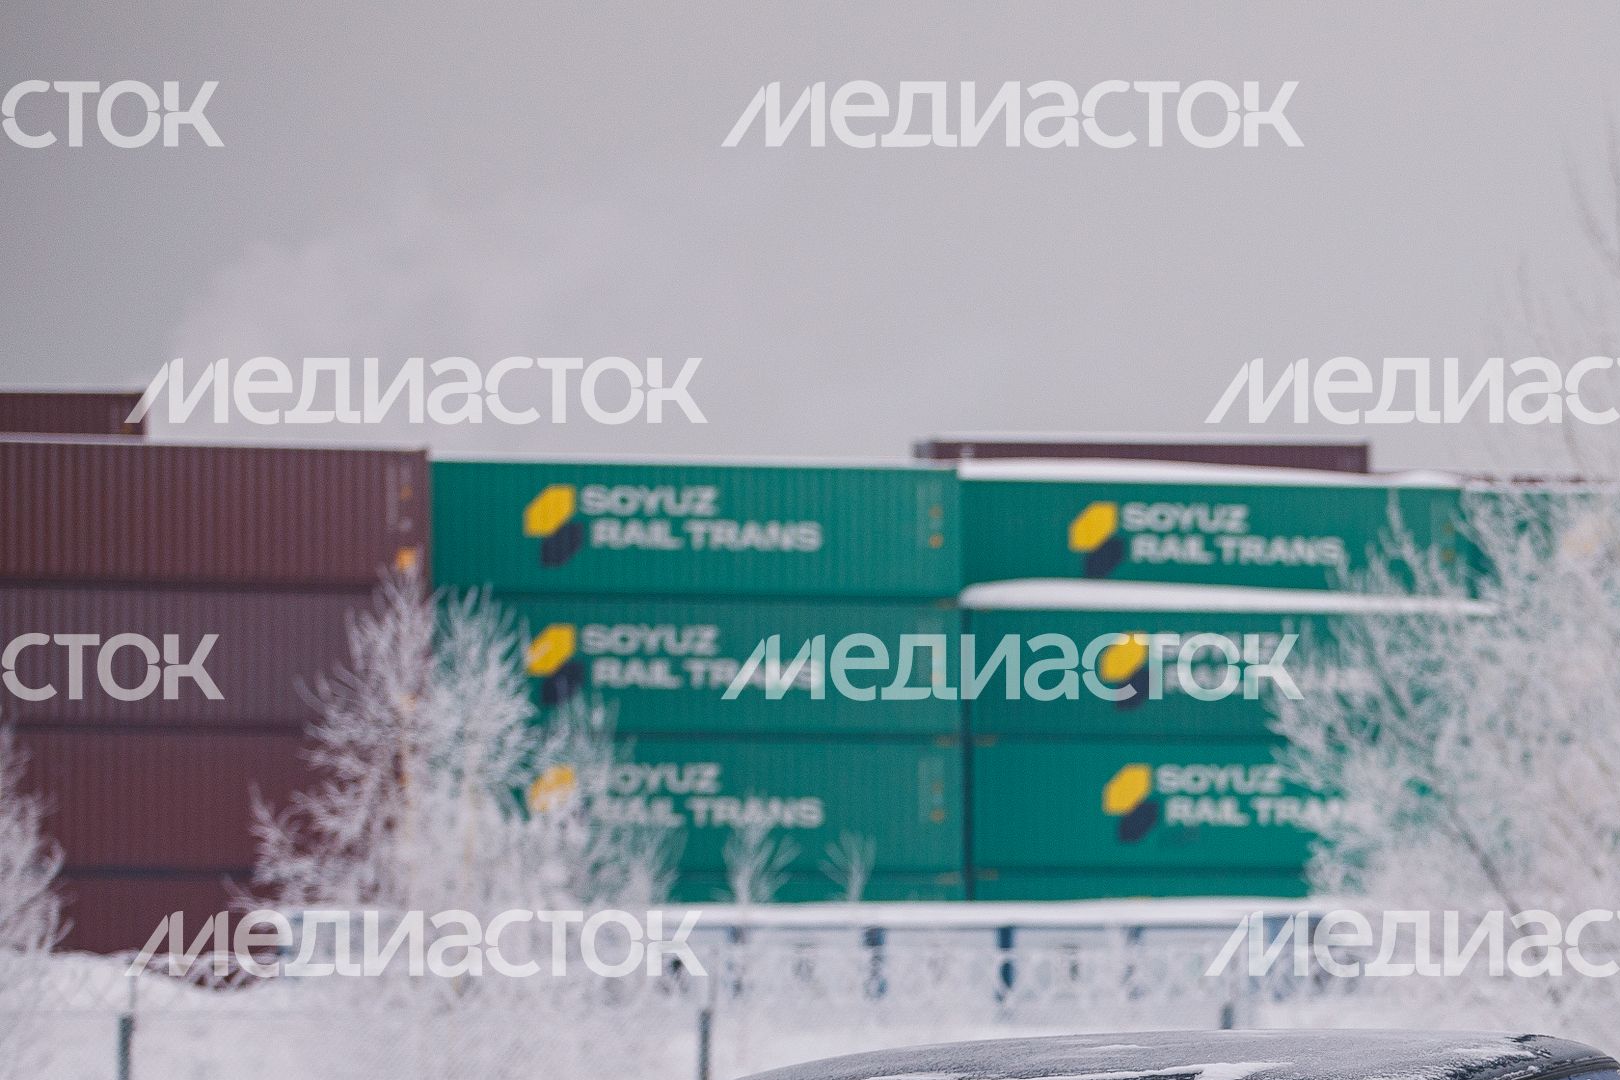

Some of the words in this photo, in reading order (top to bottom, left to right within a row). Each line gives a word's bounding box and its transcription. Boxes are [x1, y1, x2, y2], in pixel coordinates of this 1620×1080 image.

[580, 485, 719, 516] SOYUZ
[1122, 503, 1249, 533] SOYUZ
[592, 520, 683, 550] RAIL
[683, 520, 822, 551] TRANS
[1131, 535, 1216, 564] RAIL
[581, 624, 719, 655] SOYUZ
[592, 658, 682, 688] RAIL
[1165, 797, 1249, 827] RAIL
